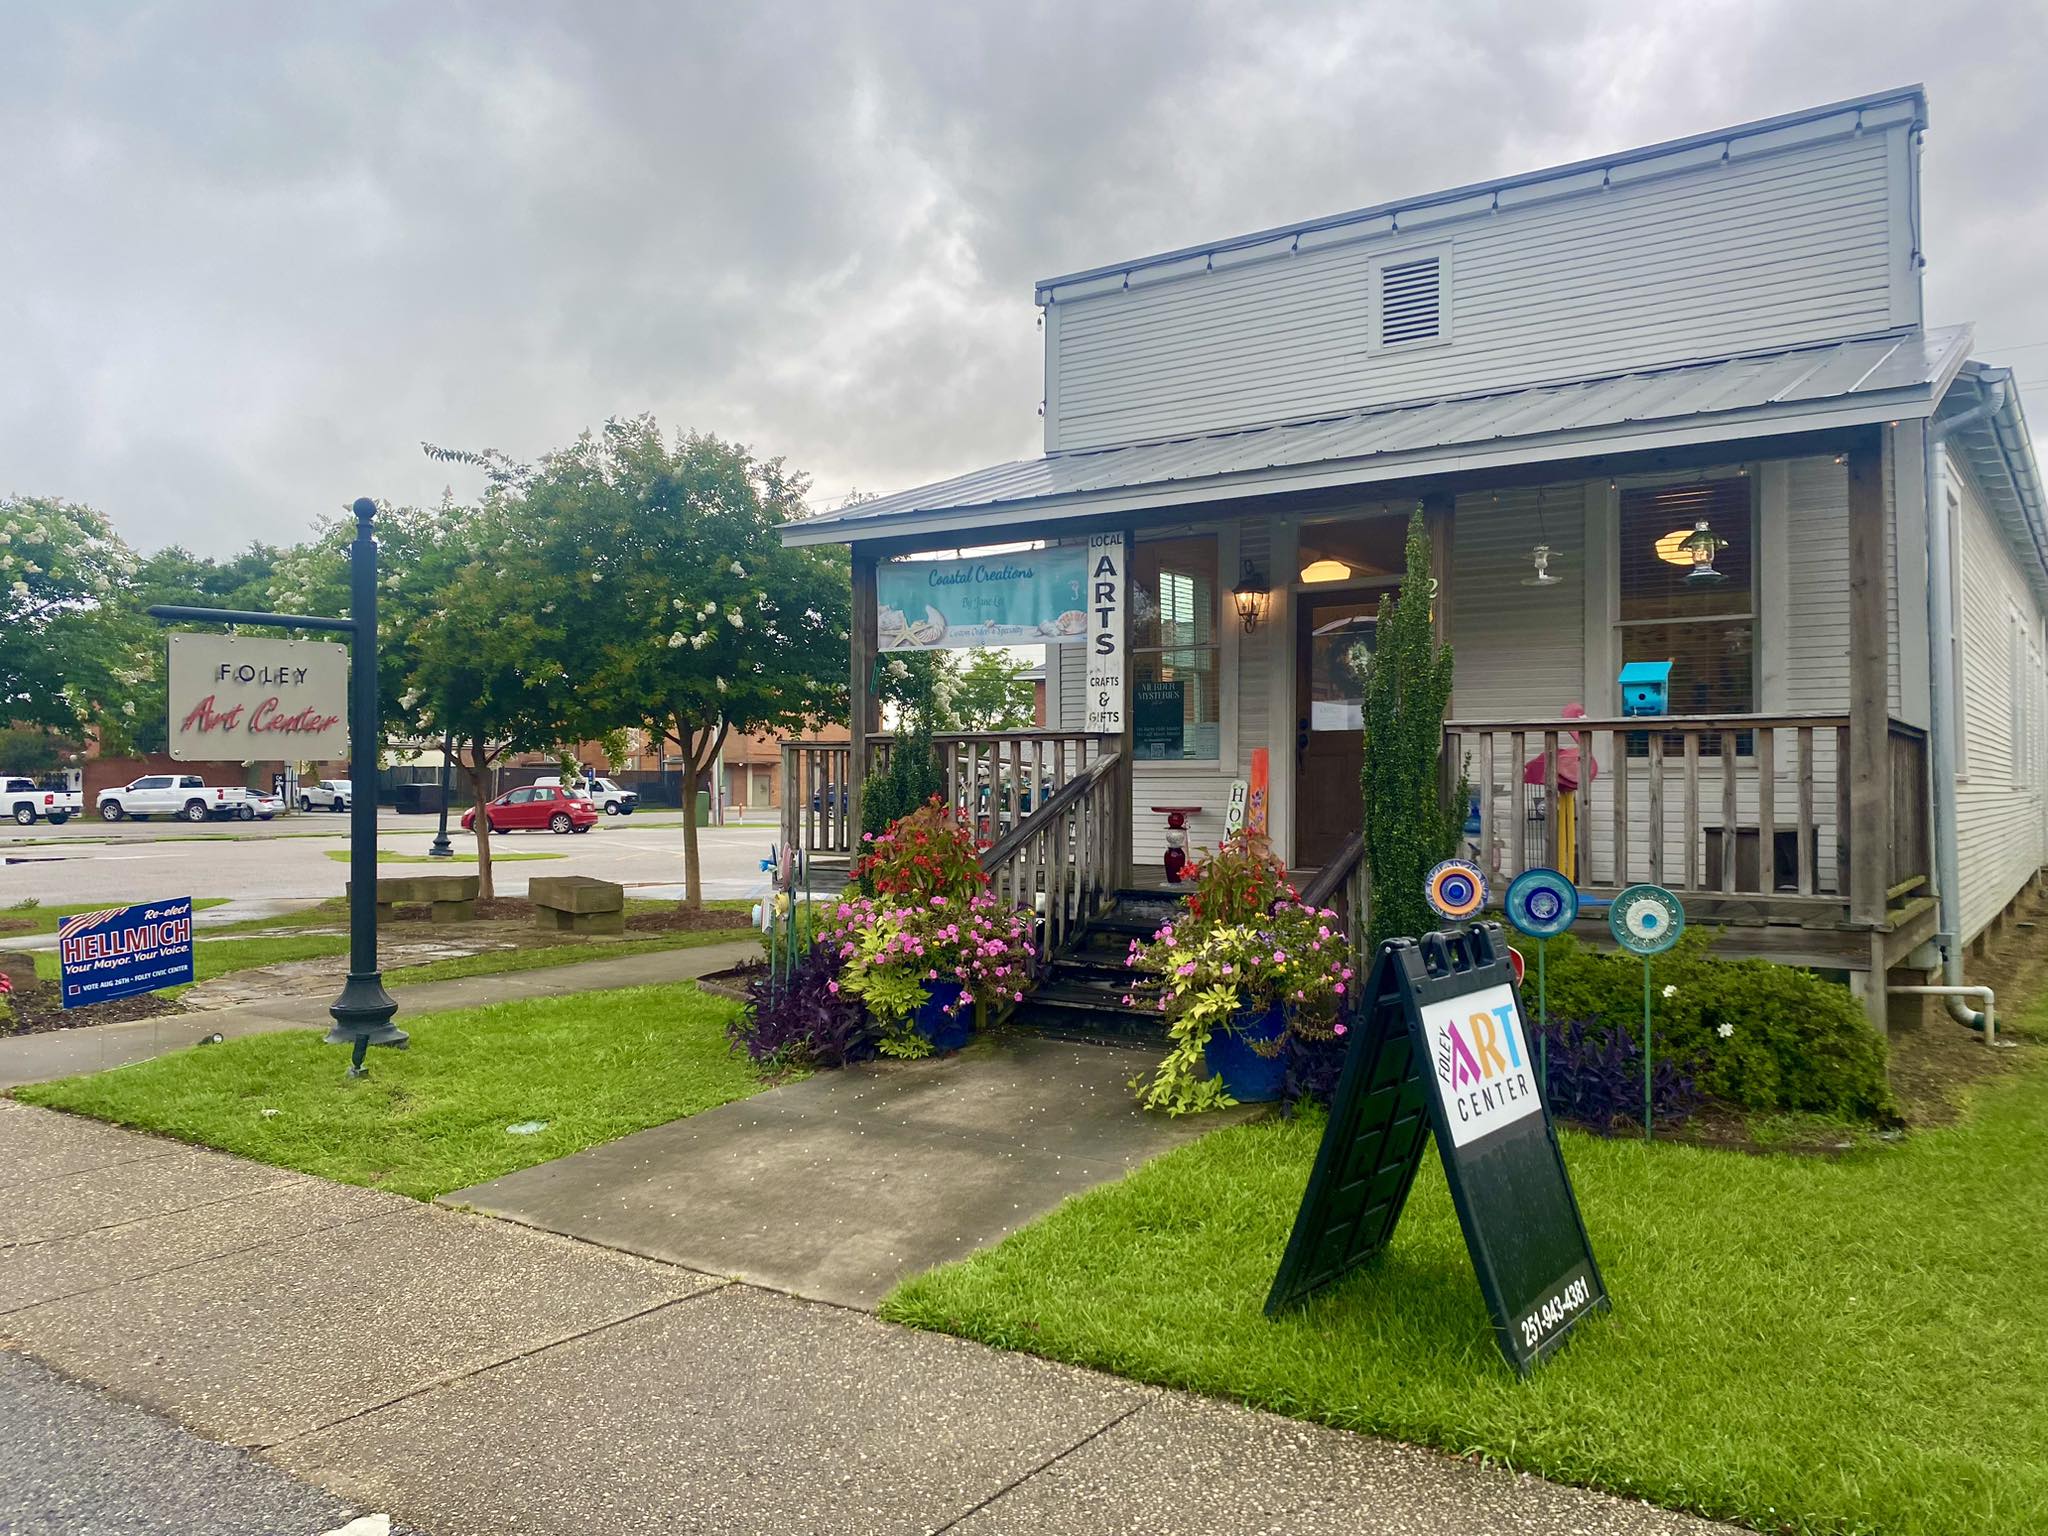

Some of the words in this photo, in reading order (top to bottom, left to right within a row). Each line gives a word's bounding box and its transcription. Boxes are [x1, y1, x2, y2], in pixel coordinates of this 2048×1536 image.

[1090, 534, 1122, 548] LOCAL
[928, 566, 973, 587] Coastal
[975, 565, 1036, 584] Creations
[1093, 555, 1117, 655] ARTS
[220, 664, 307, 684] FOLEY
[1090, 676, 1119, 687] CRAFTS
[1098, 691, 1110, 707] &
[1138, 691, 1180, 700] MYSTERIES
[1142, 683, 1176, 692] MURDER
[183, 694, 244, 733] Art
[250, 697, 339, 733] Center
[1089, 711, 1119, 723] GIFTS
[144, 903, 190, 920] Re-elect
[62, 918, 190, 965] HELLMICH
[65, 963, 92, 975] Your
[94, 956, 131, 970] Mayor.
[134, 951, 158, 962] Your
[160, 945, 190, 957] Voice.
[83, 982, 99, 991] VOTE
[100, 980, 114, 988] AUG
[114, 977, 130, 986] 26TH
[134, 972, 151, 982] FOLEY
[152, 969, 167, 977] CIVIC
[167, 964, 188, 974] CENTER
[1438, 1026, 1451, 1084] FOLEY
[1447, 1003, 1521, 1093] ART
[1457, 1074, 1529, 1122] CENTER
[1521, 1275, 1590, 1347] 251-943-4381
